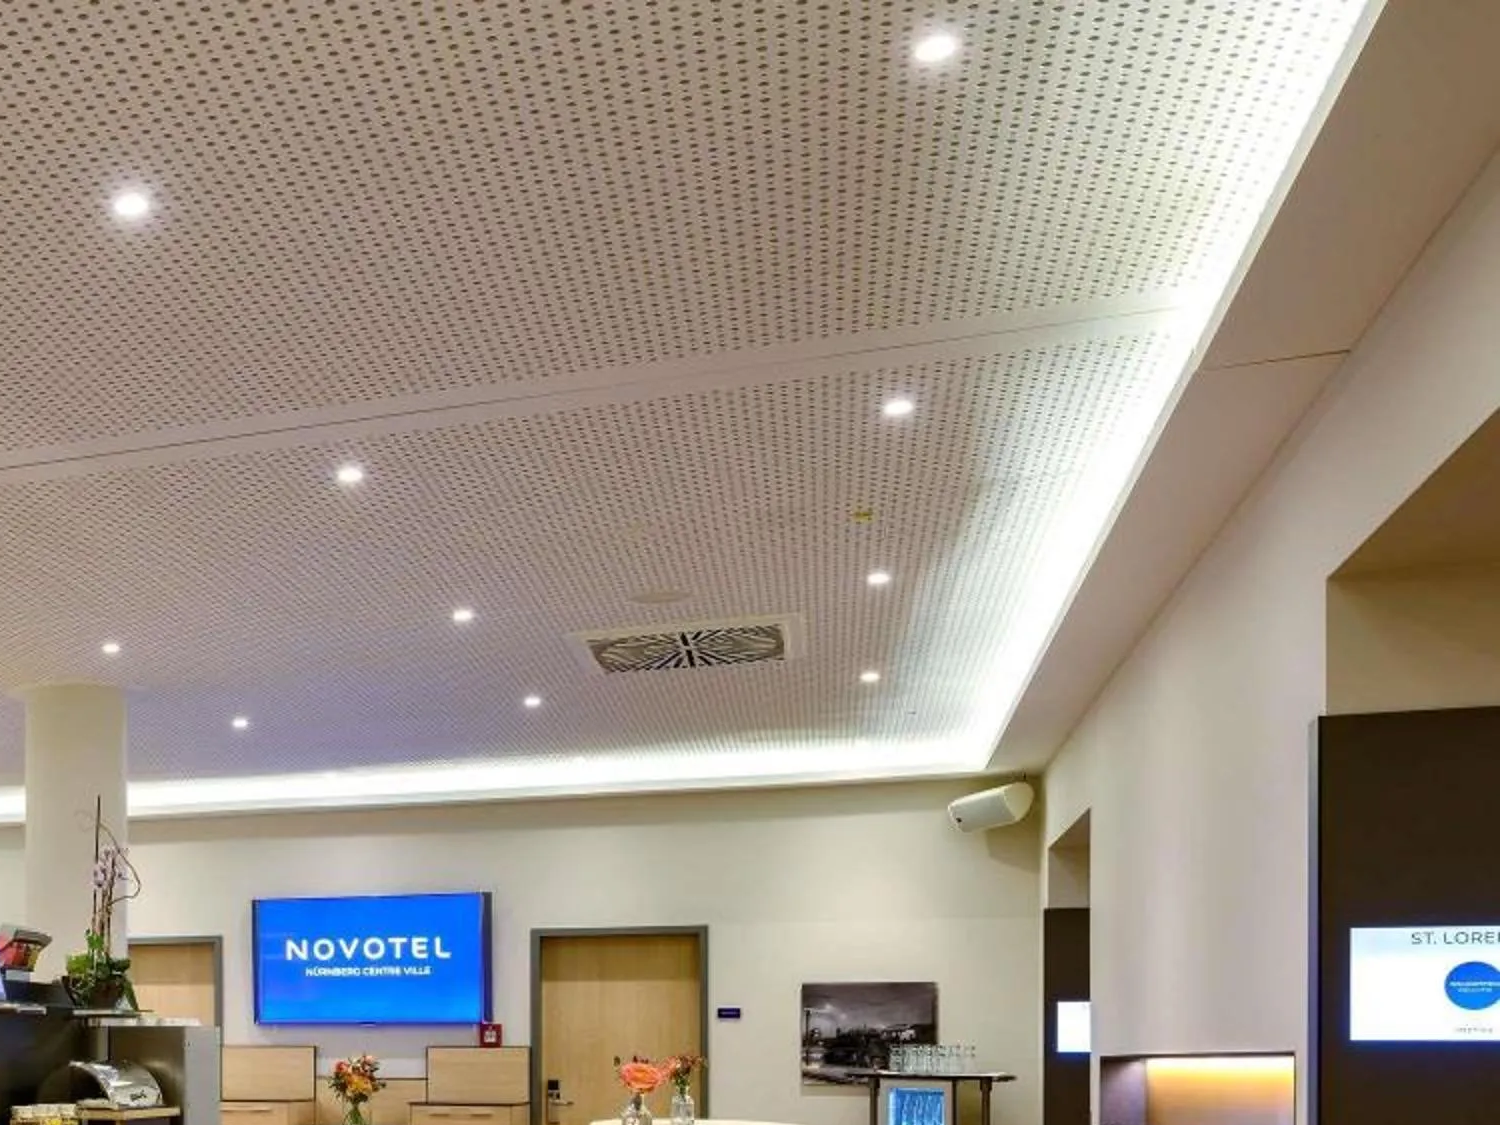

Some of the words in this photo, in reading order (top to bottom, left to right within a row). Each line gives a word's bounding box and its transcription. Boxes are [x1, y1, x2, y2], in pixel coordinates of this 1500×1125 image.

[1411, 931, 1437, 945] ST.
[1443, 931, 1500, 945] LORE
[285, 936, 452, 961] NOVOTEL
[305, 966, 361, 977] NÜRNBERG
[363, 965, 401, 976] CENTRE
[403, 965, 432, 975] VILLE
